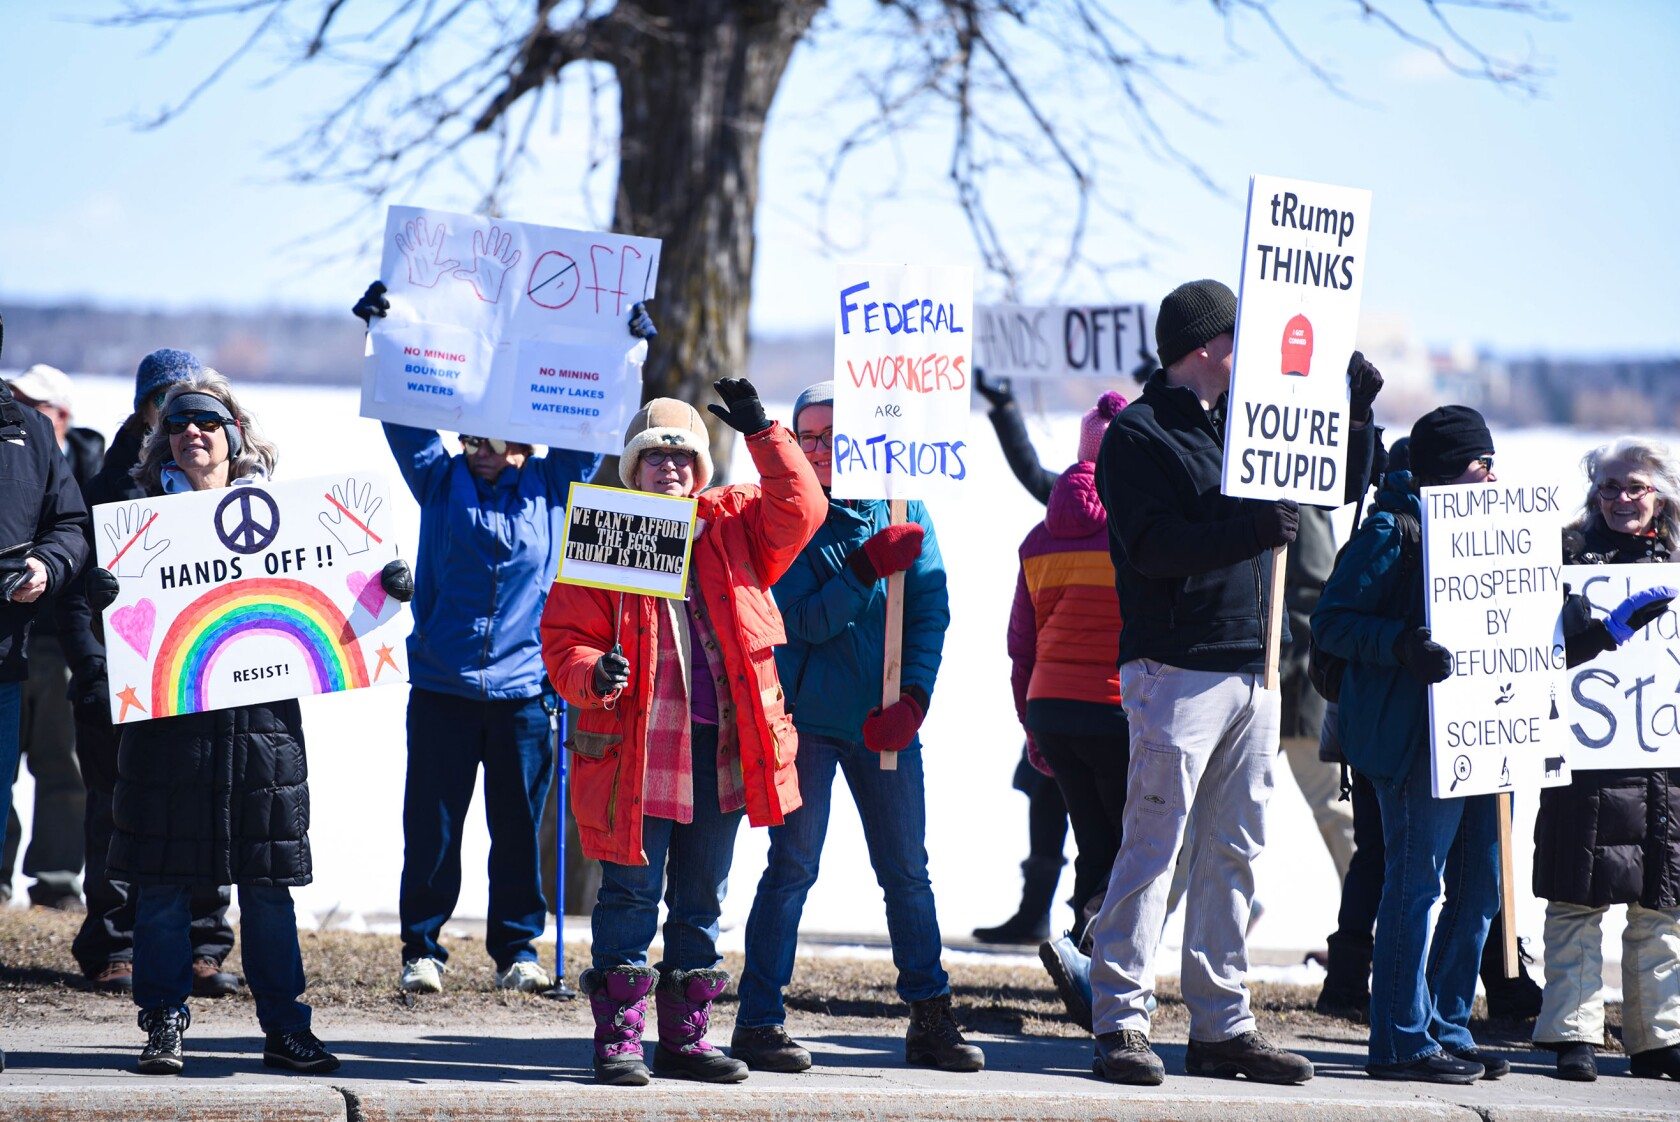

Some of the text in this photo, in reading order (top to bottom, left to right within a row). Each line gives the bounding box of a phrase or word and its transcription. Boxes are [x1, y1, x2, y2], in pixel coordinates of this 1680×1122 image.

[1271, 192, 1354, 246] tRump
[1257, 245, 1354, 290] THINKS
[840, 281, 963, 335] FEDERAL
[404, 347, 465, 362] NO MINING
[405, 364, 460, 379] BOUNDRY
[539, 367, 599, 381] NO MINING
[847, 353, 965, 393] WORKERS
[407, 382, 454, 396] WATERS
[530, 384, 604, 399] RAINY LAKES
[531, 402, 600, 417] WATERSHED
[1244, 402, 1339, 446] YOU'RE
[834, 434, 966, 481] PATRIOTS
[1240, 449, 1336, 491] STUPID
[1430, 486, 1559, 519] TRUMP-MUSK
[572, 507, 688, 539] WE CAN'T AFFORD
[568, 541, 683, 573] TRUMP IS LAYING
[597, 529, 657, 553] THE EGGS
[1452, 528, 1531, 558] KILLING
[160, 556, 243, 589] HANDS
[1435, 566, 1561, 602] PROSPERITY
[1487, 608, 1511, 635] BY
[233, 664, 289, 683] RESIST!
[1447, 718, 1540, 747] SCIENCE
